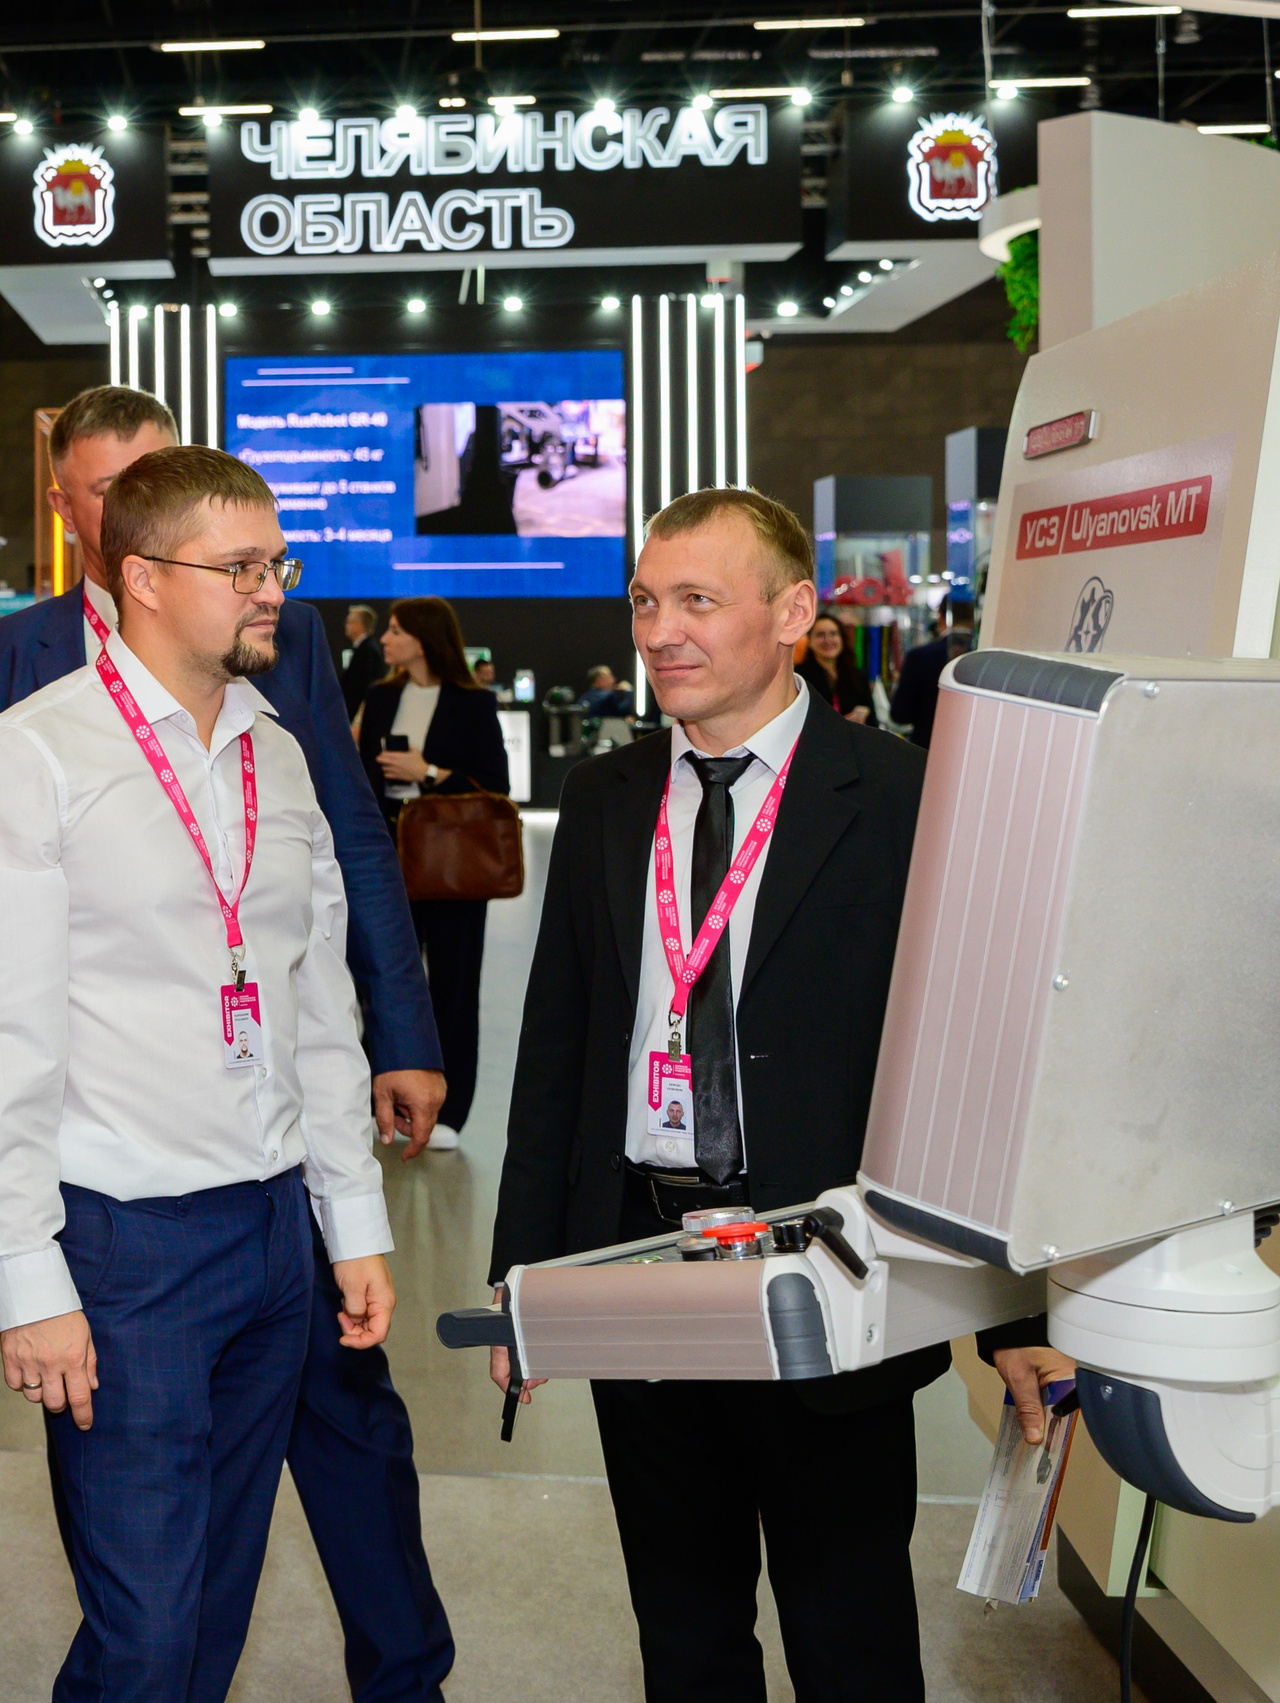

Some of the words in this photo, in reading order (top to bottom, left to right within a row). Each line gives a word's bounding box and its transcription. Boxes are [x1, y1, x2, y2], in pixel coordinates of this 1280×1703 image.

[240, 103, 768, 180] ЧЕЛЯБИНСКАЯ
[239, 187, 576, 255] ОБЛАСТЬ
[1070, 495, 1162, 547] Ulyanovsk
[1164, 485, 1202, 526] MT
[224, 995, 232, 1038] EXHIBITOR
[652, 1060, 661, 1103] EXHIBITOR
